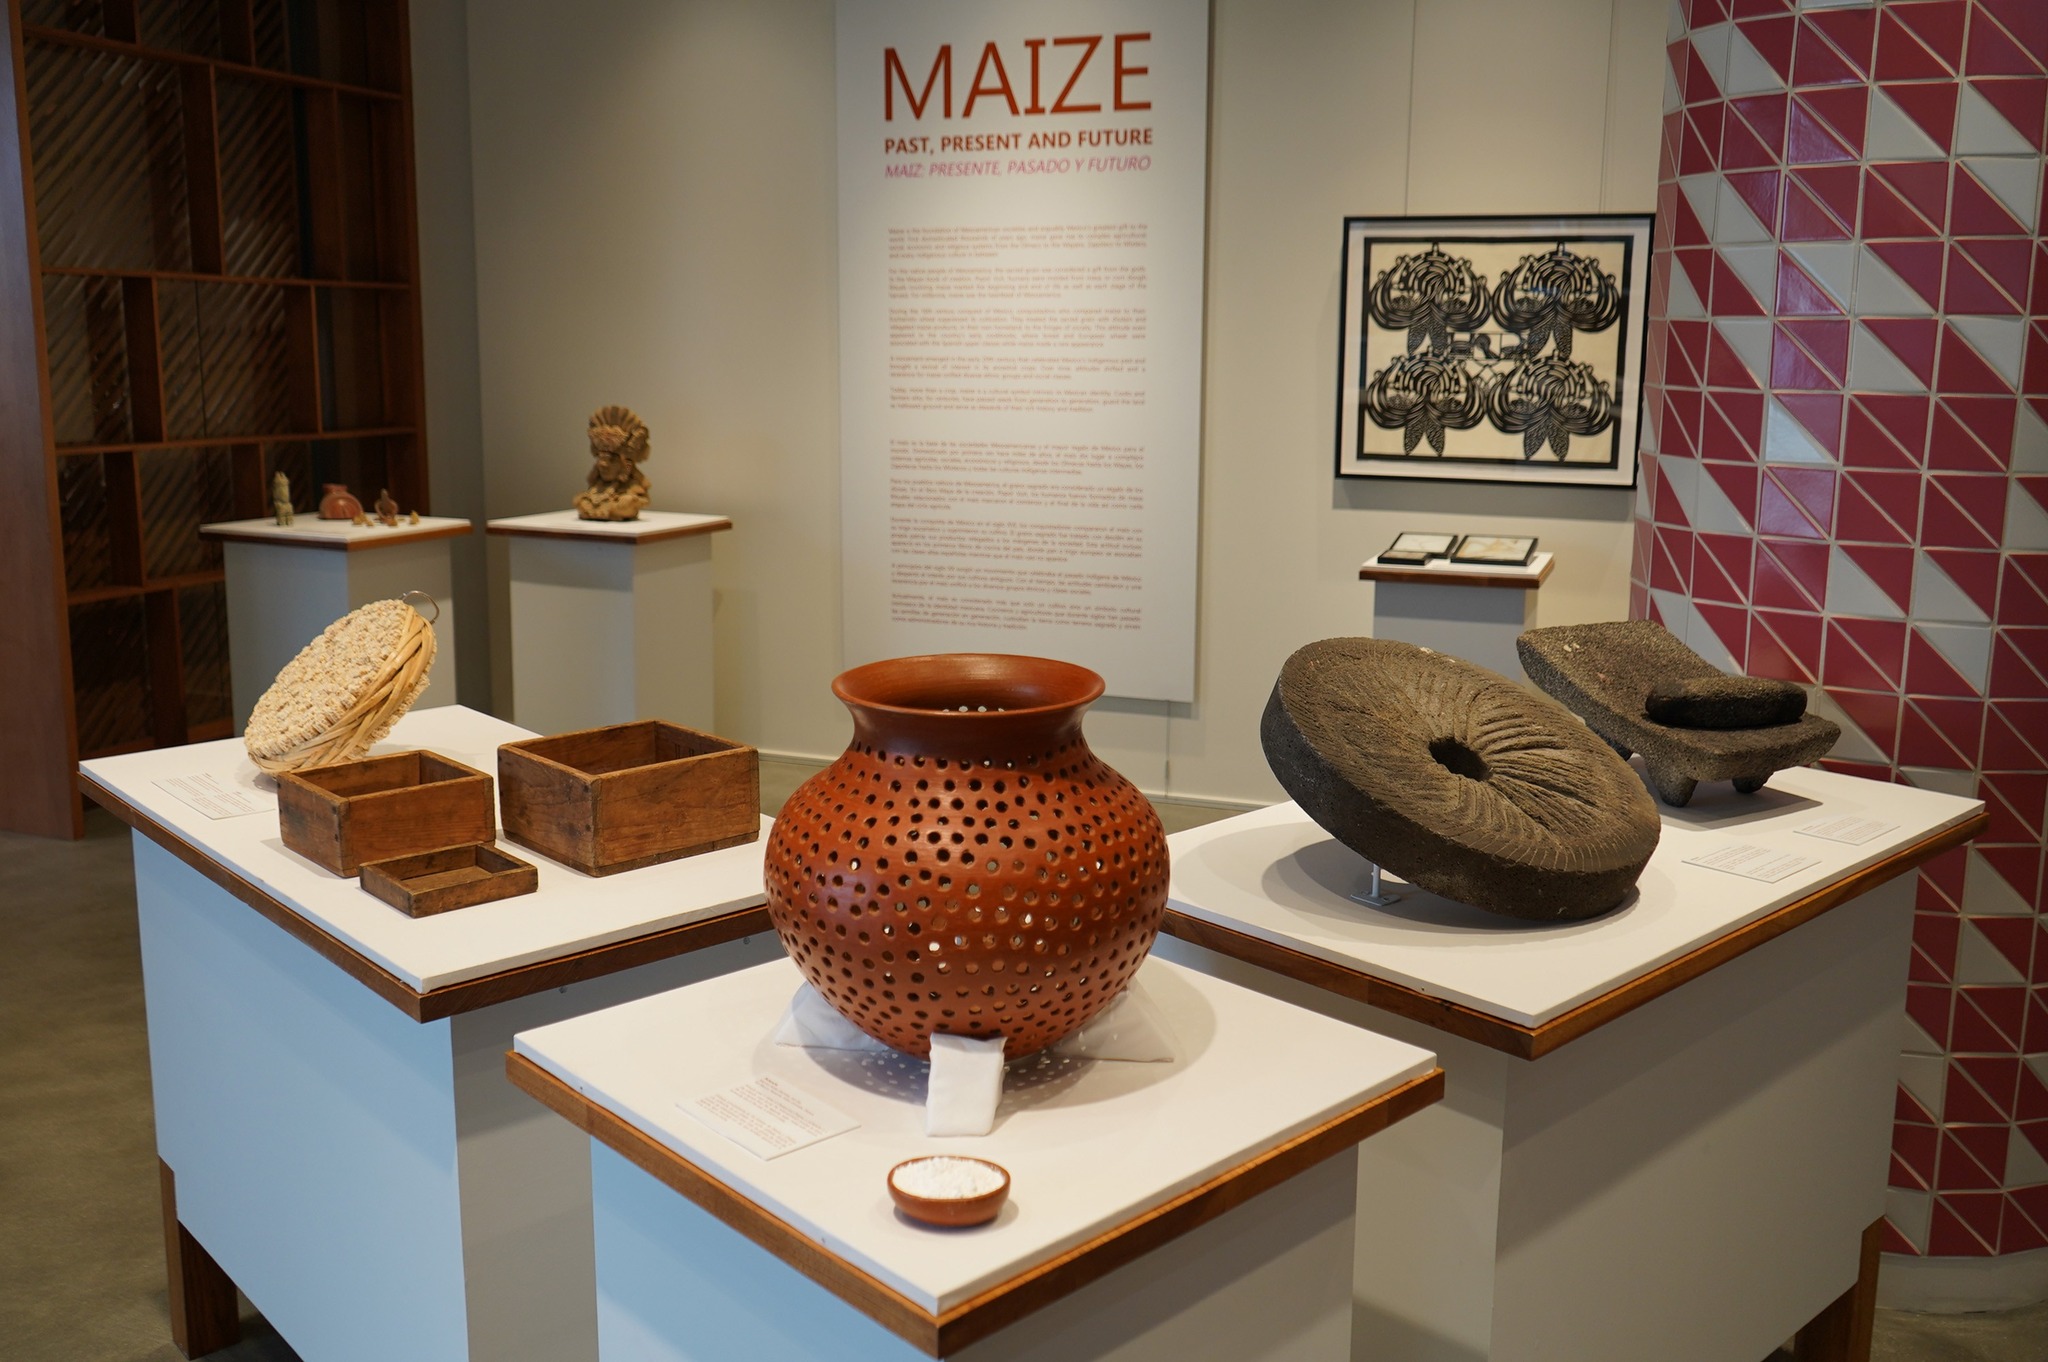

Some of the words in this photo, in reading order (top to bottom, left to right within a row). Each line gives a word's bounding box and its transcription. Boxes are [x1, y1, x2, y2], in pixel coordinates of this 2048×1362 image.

[884, 31, 1152, 122] MAIZE
[885, 136, 934, 155] PAST,
[941, 133, 1022, 152] PRESENT
[1028, 131, 1071, 149] AND
[1078, 128, 1153, 147] FUTURE
[1007, 158, 1070, 175] PASADO
[1074, 157, 1085, 172] Y
[1087, 155, 1152, 172] FUTURO
